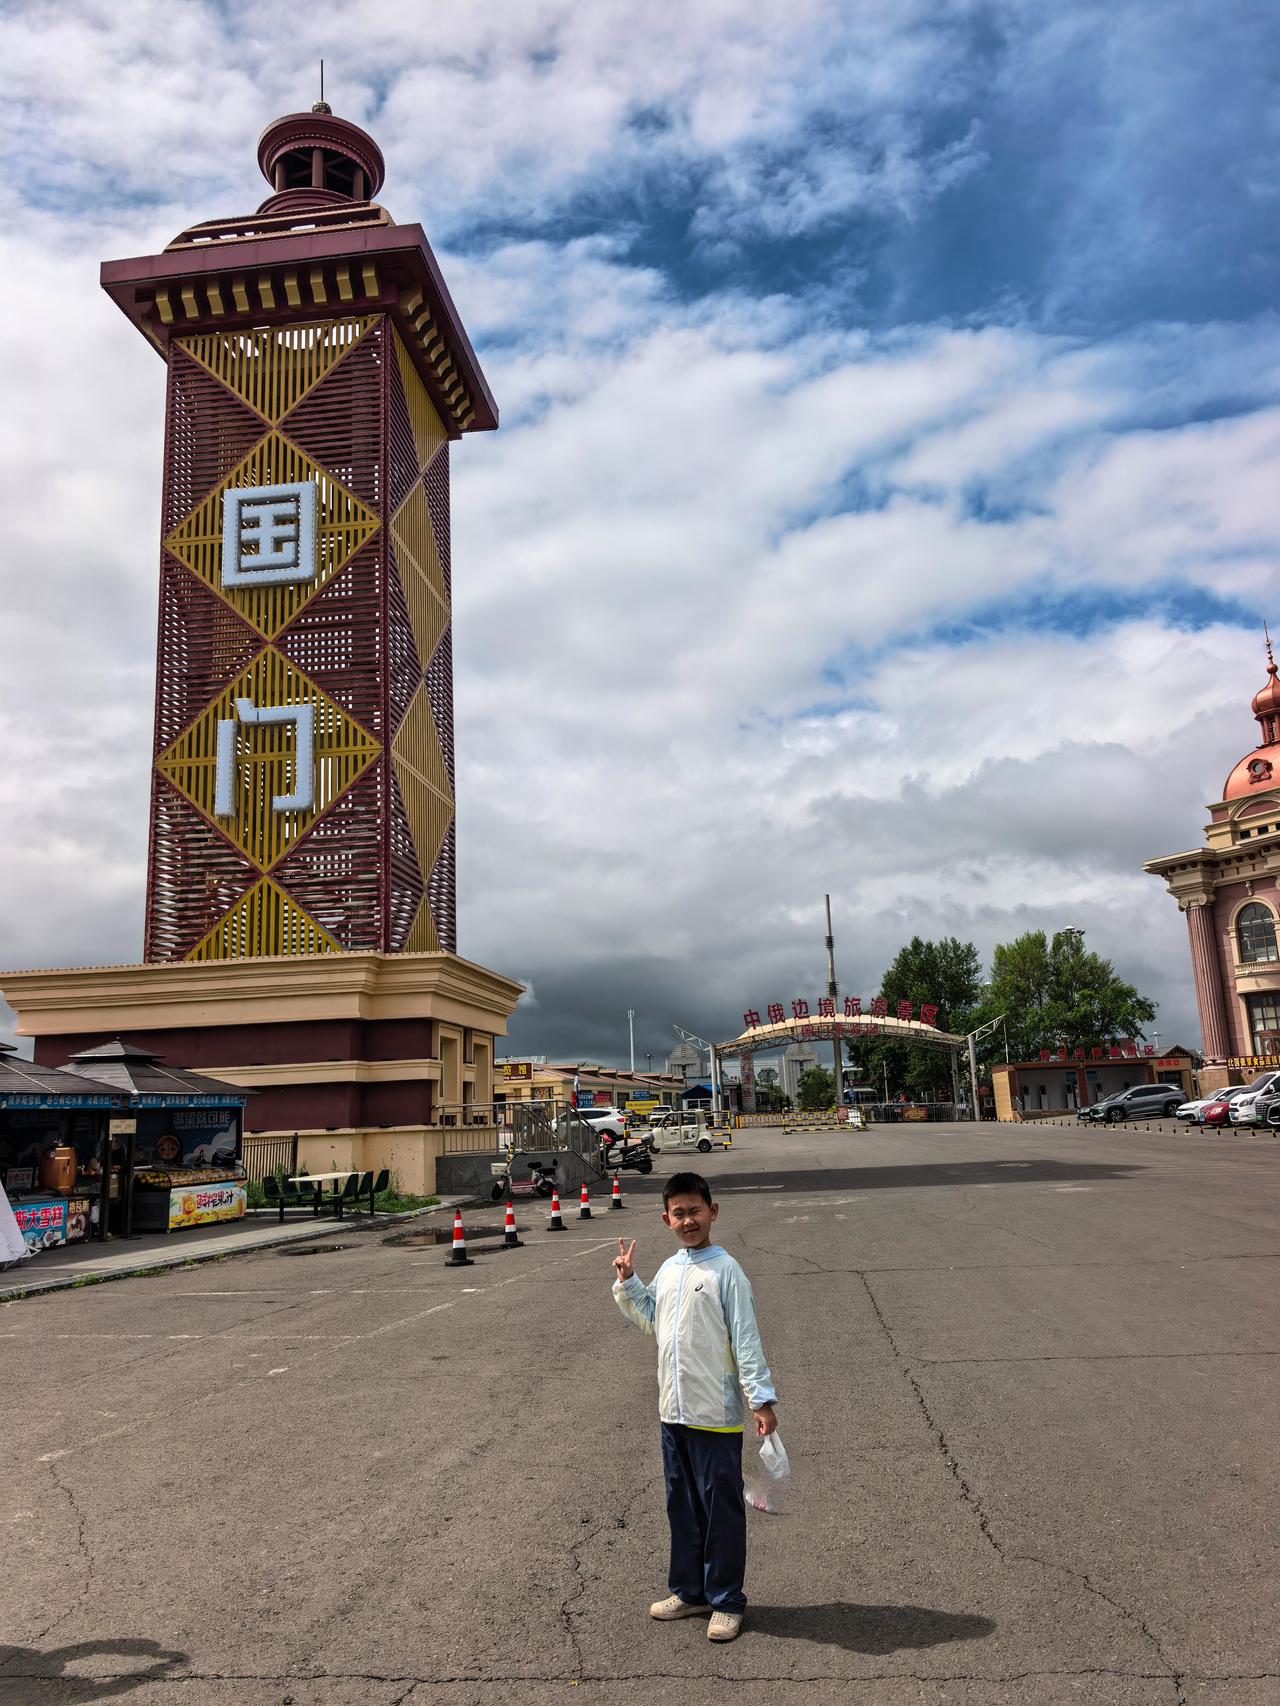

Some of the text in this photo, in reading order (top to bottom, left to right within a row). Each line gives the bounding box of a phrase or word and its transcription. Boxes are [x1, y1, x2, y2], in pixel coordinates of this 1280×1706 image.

[214, 480, 318, 818] 国门
[743, 996, 940, 1030] 中俄边境旅游景区
[173, 1110, 231, 1125] 渴望就可能
